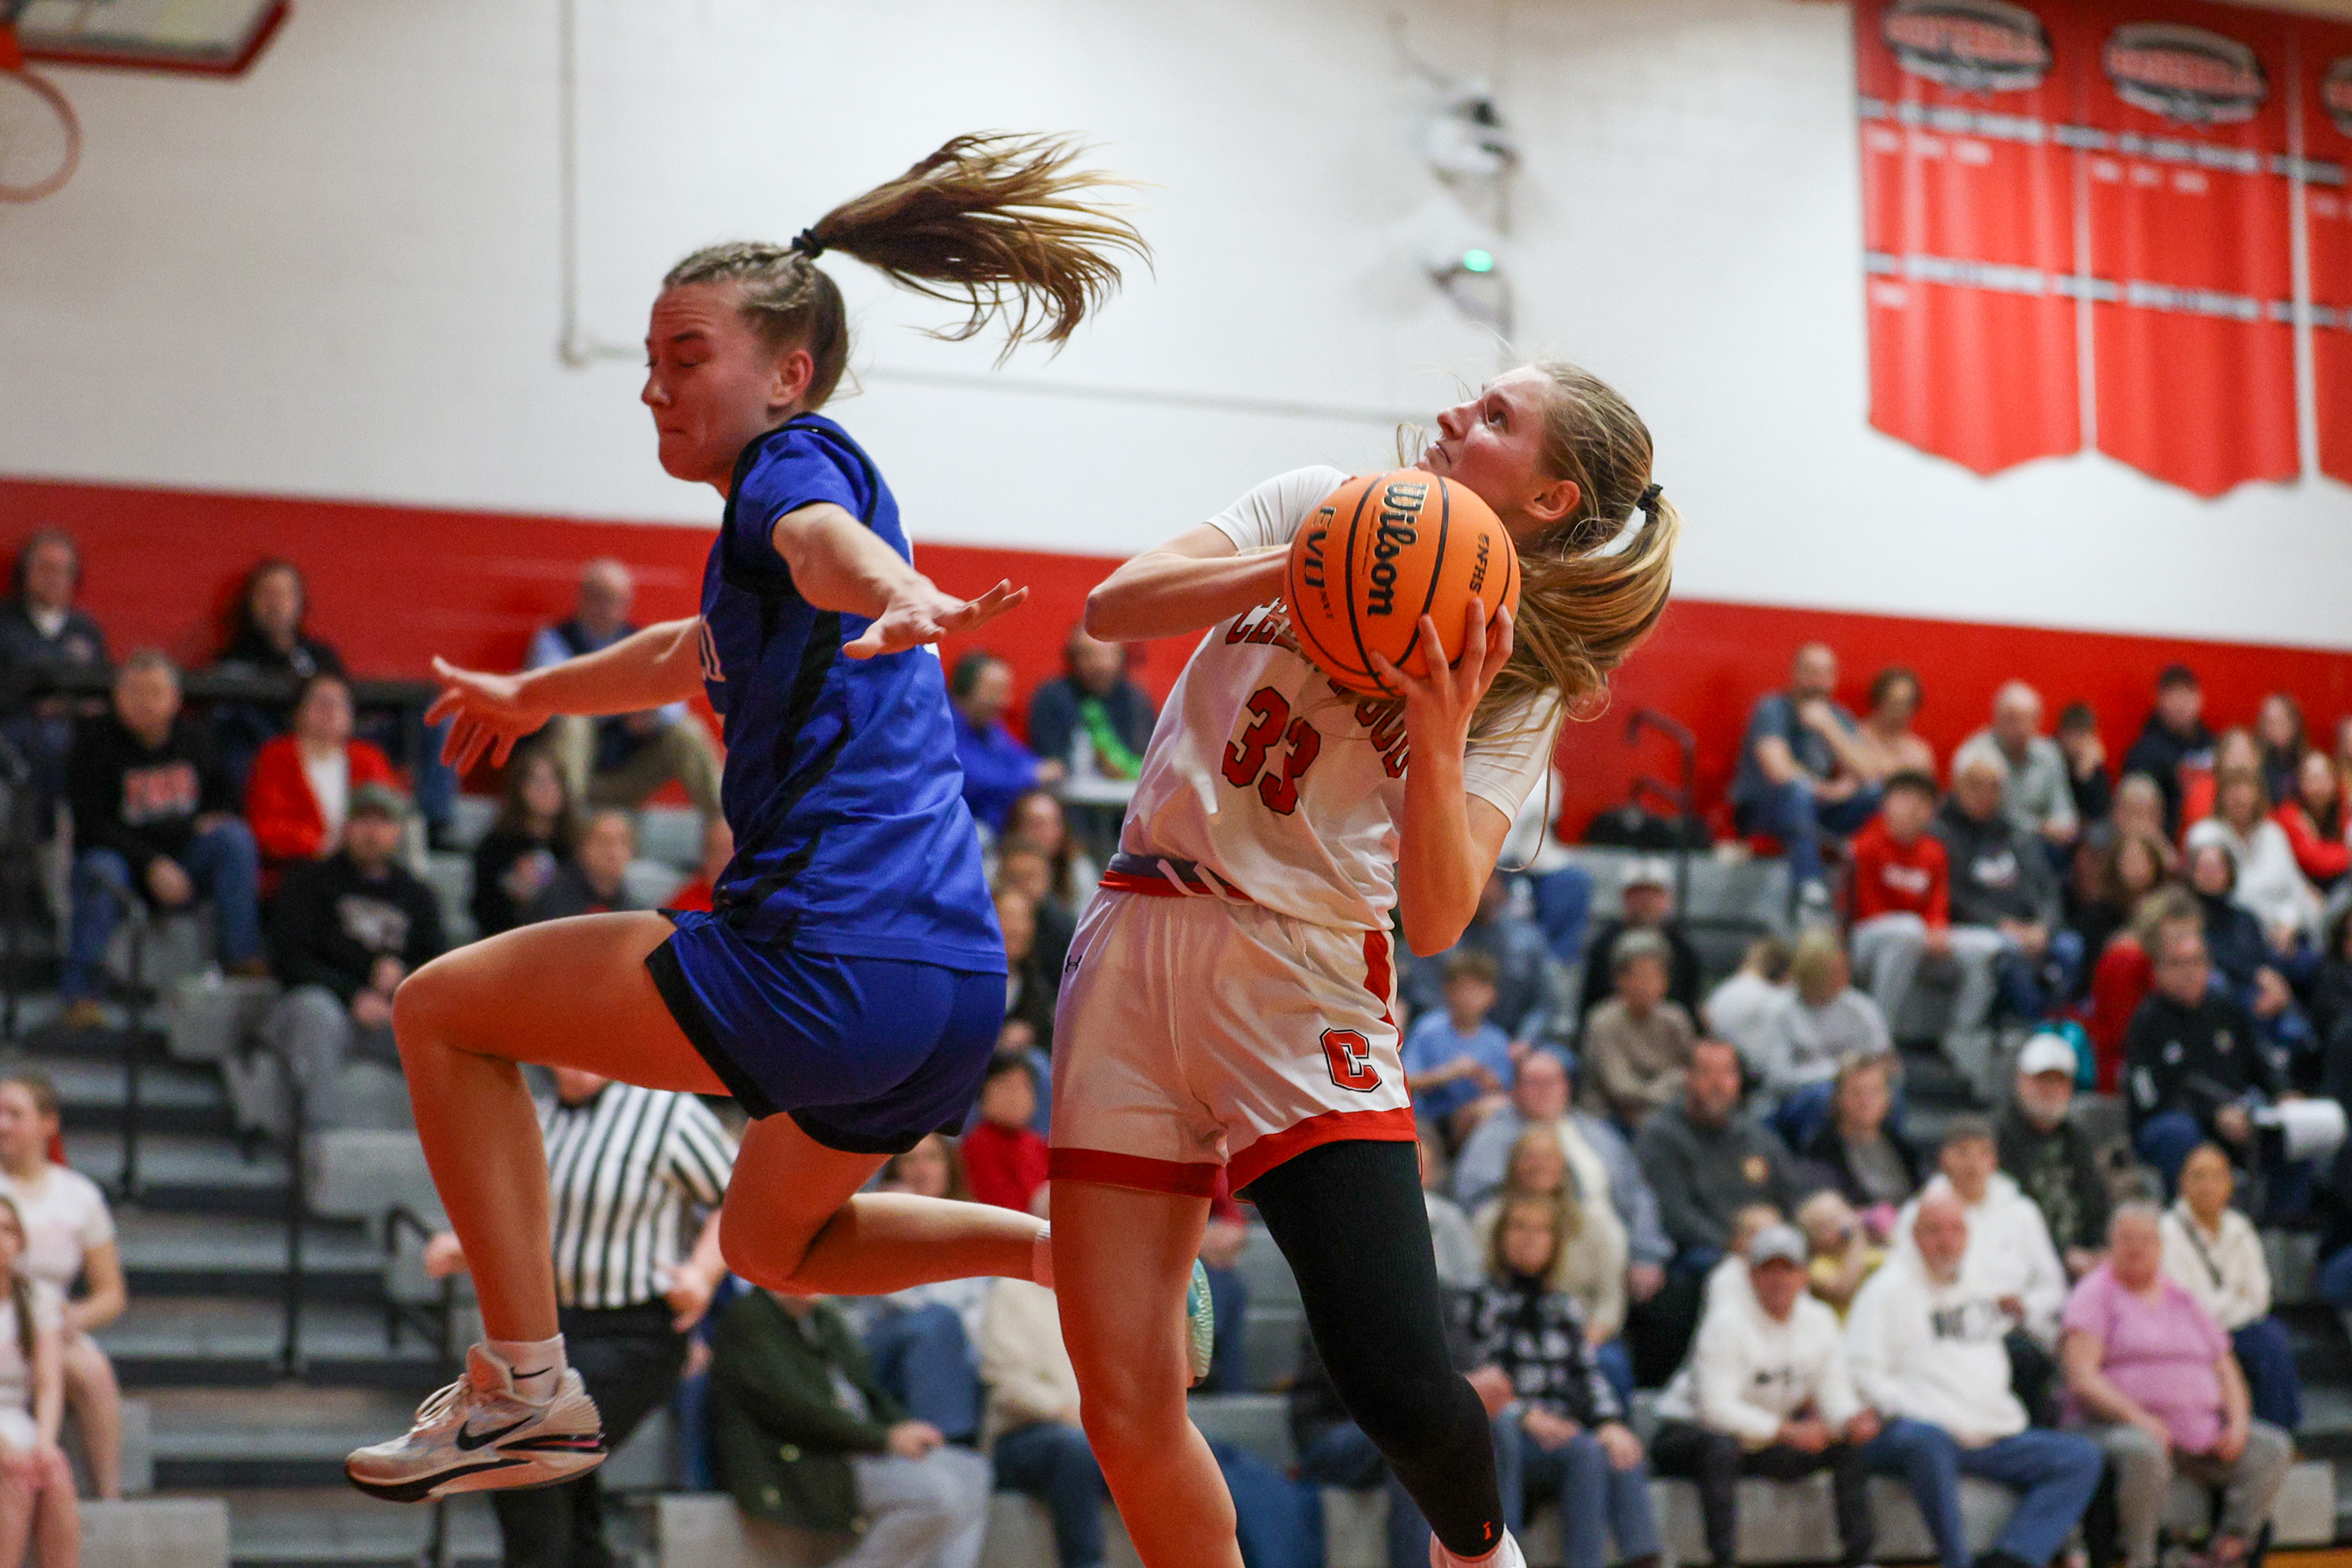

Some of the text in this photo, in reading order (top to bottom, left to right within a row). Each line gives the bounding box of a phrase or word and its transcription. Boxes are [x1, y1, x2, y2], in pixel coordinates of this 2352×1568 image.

[1304, 506, 1338, 589] EVO
[1367, 481, 1430, 618] Wilson
[1221, 685, 1322, 817] 33
[1319, 1028, 1383, 1093] C
